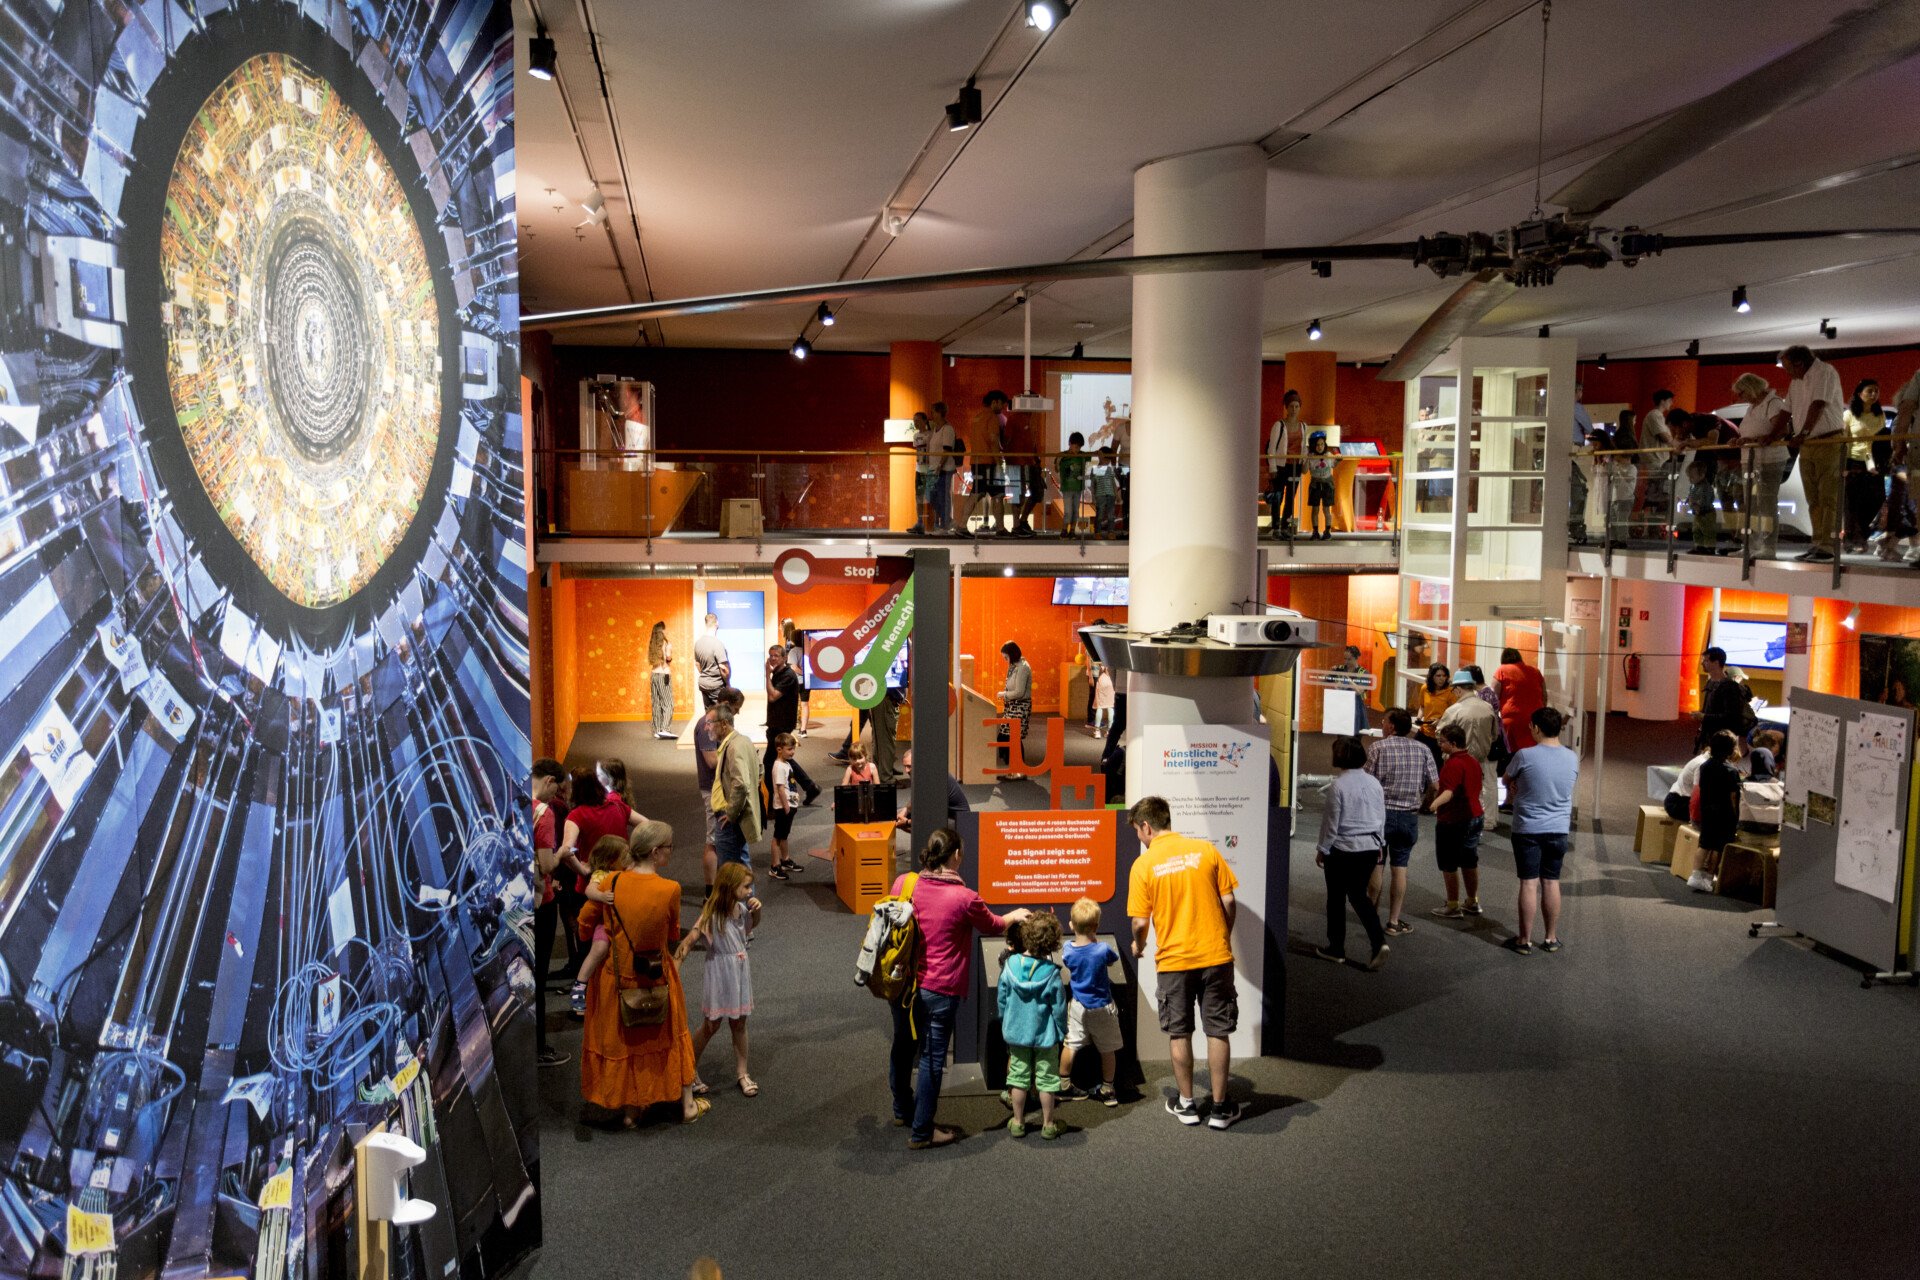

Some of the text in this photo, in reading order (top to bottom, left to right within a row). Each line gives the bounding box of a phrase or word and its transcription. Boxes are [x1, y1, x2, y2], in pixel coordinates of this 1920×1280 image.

[844, 566, 879, 578] Stop!
[853, 593, 900, 640] Roboter?
[881, 600, 914, 653] Mensch!
[50, 740, 67, 763] STOP
[1163, 749, 1218, 758] Künstliche
[1163, 759, 1218, 768] Intelligenz
